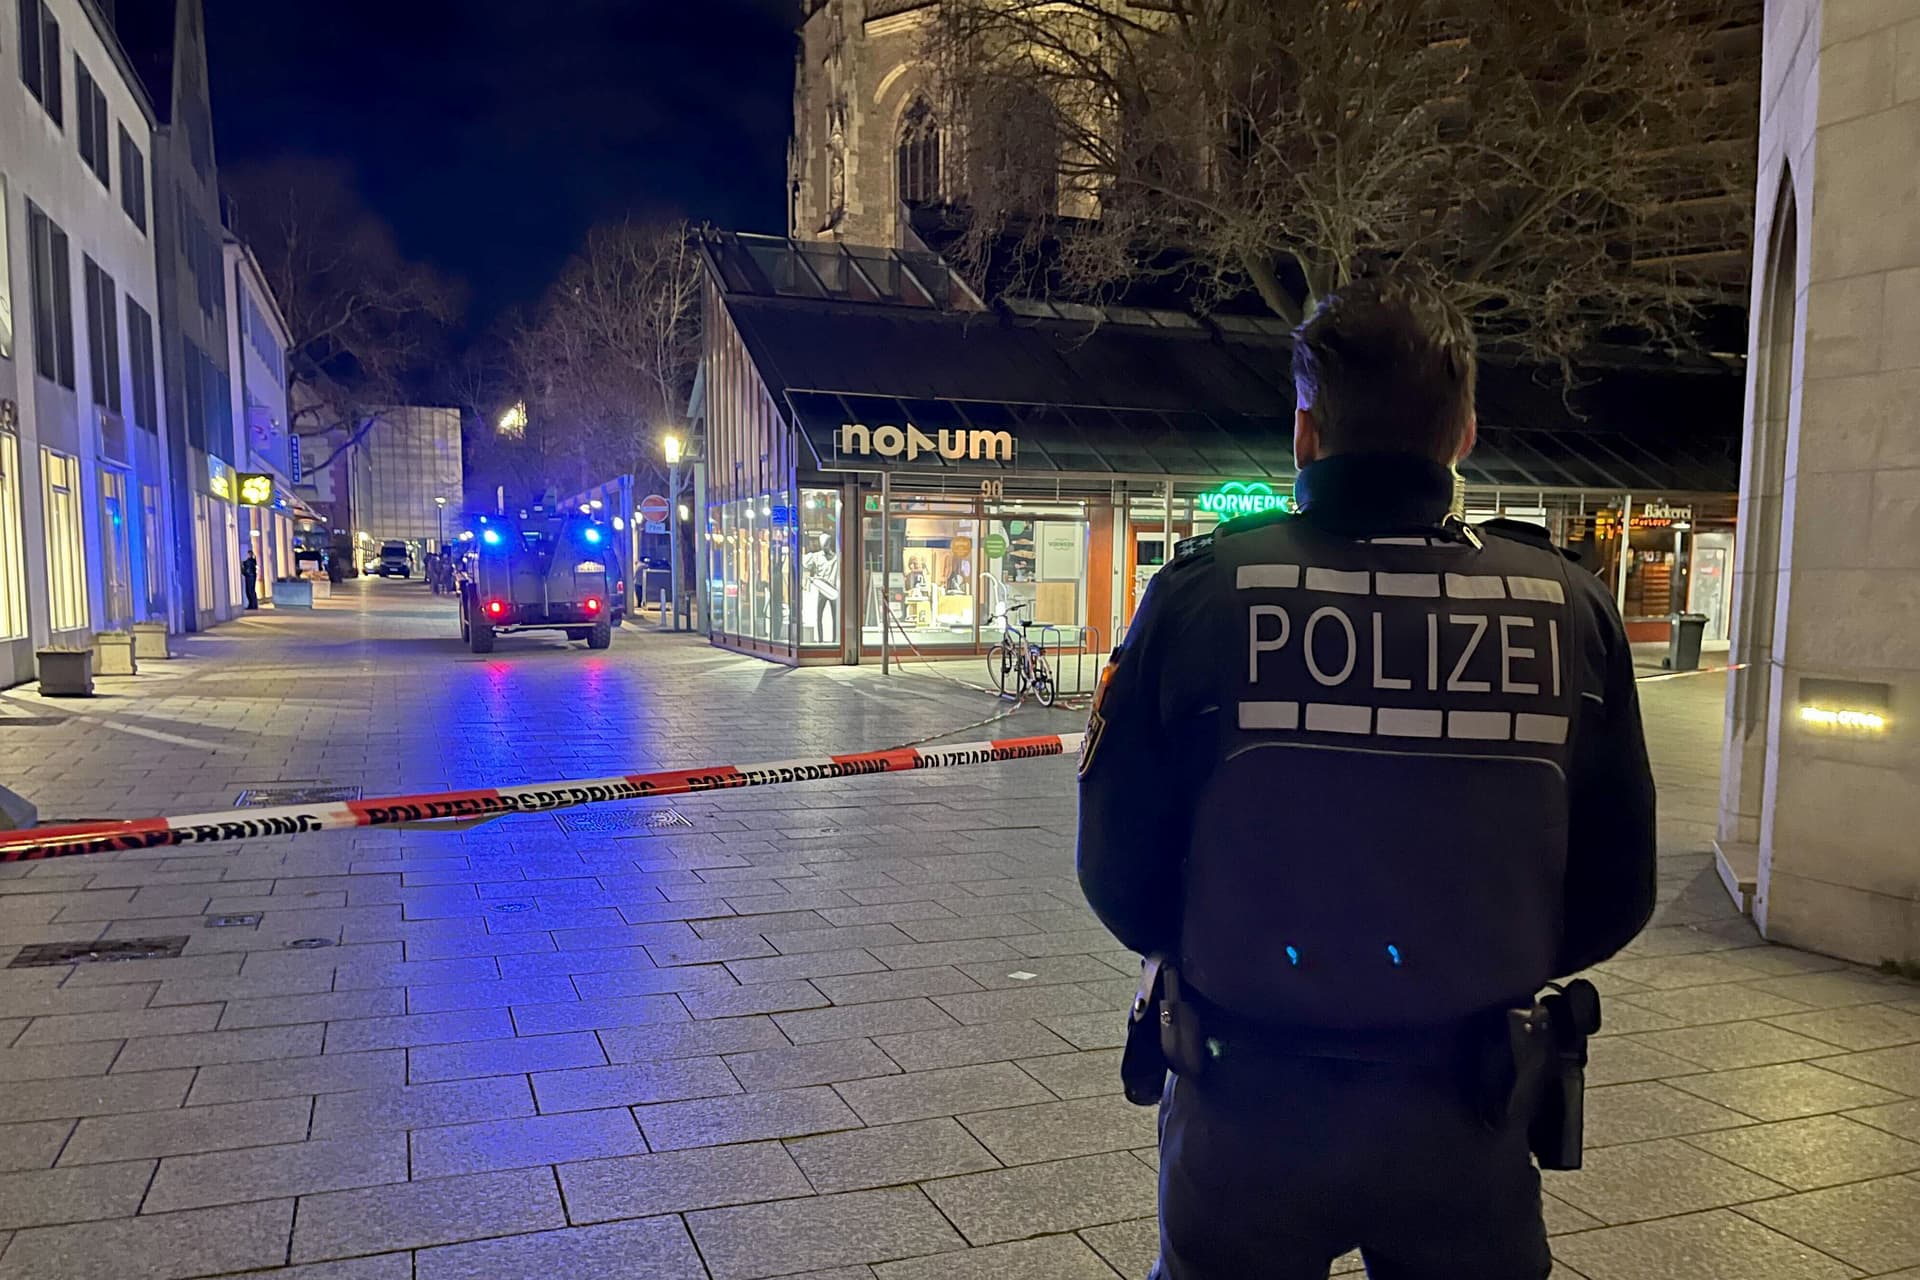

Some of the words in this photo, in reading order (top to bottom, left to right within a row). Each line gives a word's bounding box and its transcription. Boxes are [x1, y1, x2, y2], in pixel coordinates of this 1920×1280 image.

[981, 480, 1001, 498] 90
[1200, 493, 1289, 513] VORWERK
[1644, 503, 1692, 519] Bäckerei
[1250, 605, 1561, 697] POLIZEI
